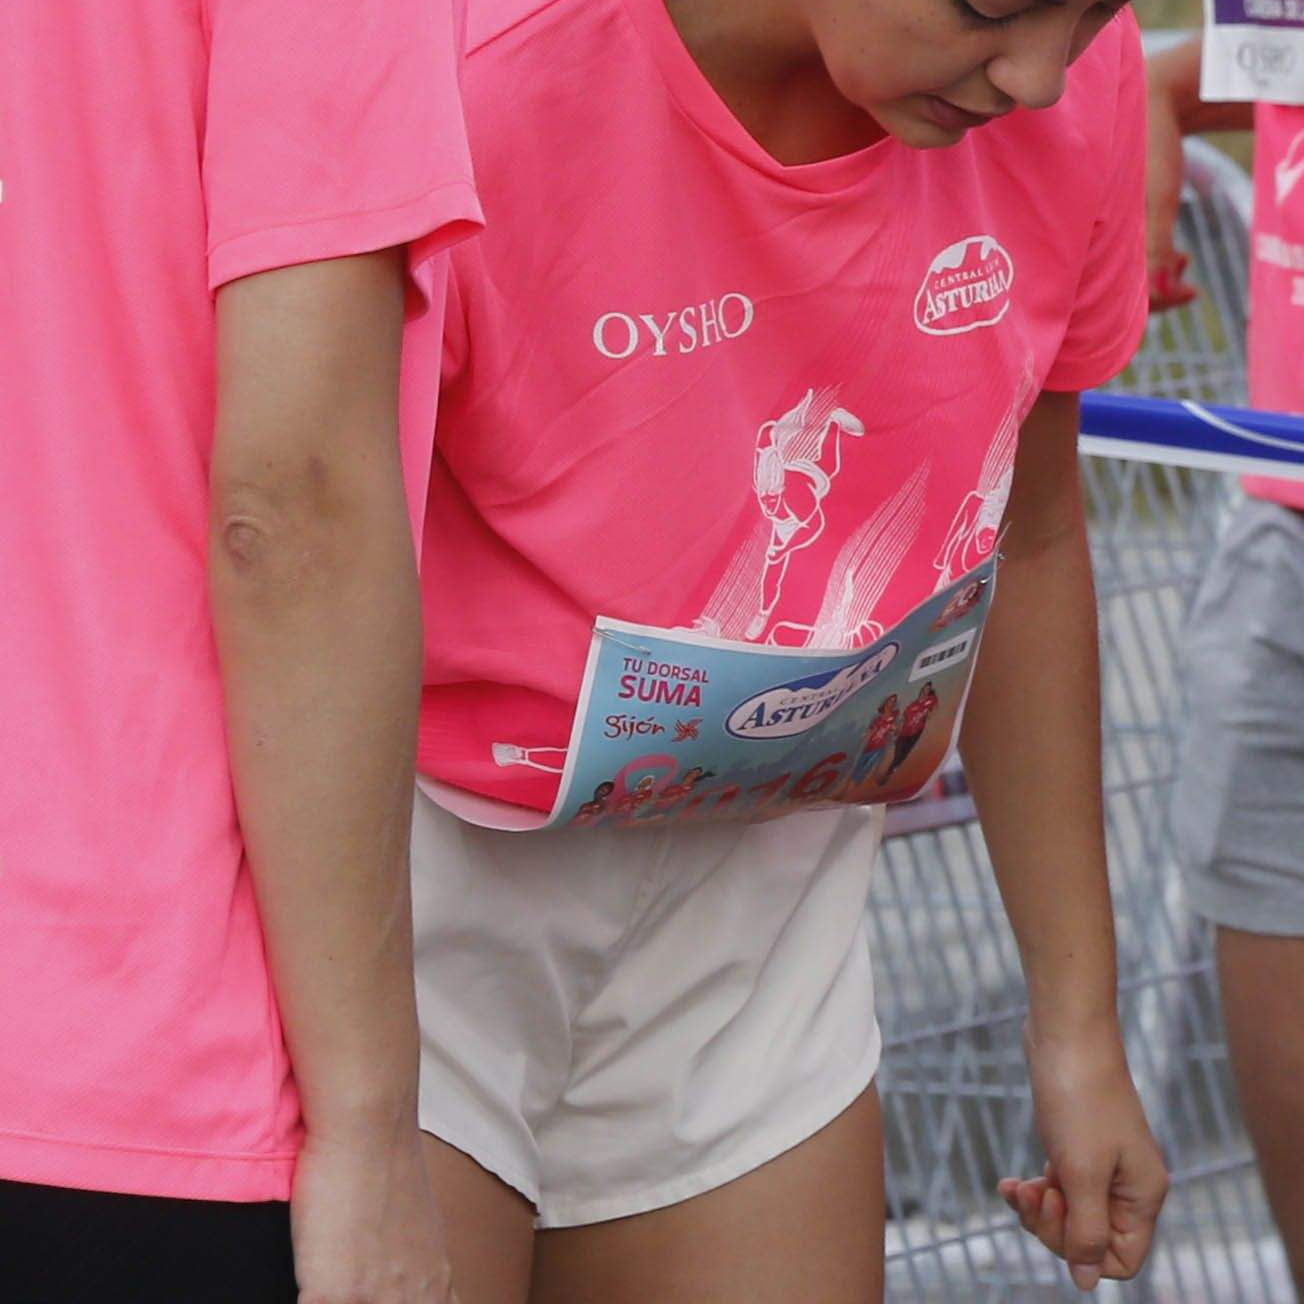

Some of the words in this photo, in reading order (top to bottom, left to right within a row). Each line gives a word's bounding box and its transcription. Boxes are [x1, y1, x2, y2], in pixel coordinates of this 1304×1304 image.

[592, 292, 755, 359] OYSHO
[623, 657, 643, 673] TU
[647, 660, 710, 684] DORSAL
[617, 674, 702, 708] SUMA
[602, 713, 666, 742] gijón
